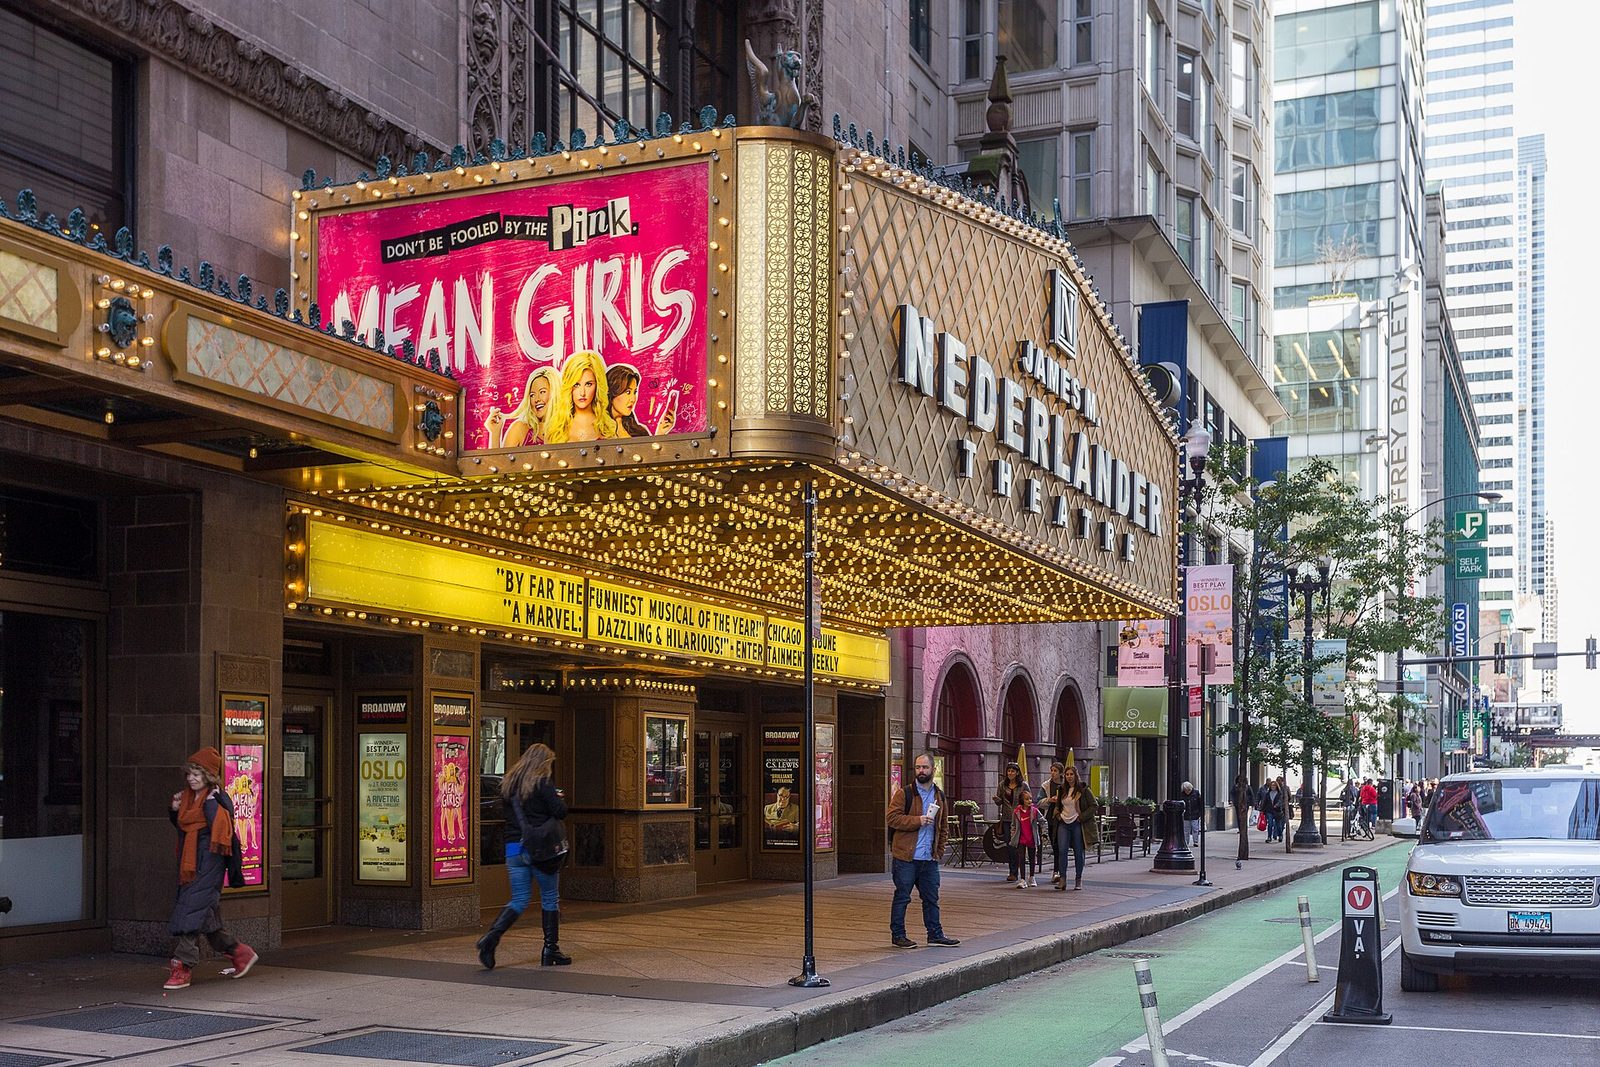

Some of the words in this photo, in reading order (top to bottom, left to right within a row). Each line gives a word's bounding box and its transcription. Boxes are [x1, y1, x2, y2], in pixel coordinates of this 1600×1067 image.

[387, 239, 425, 259] DON'T
[430, 236, 443, 251] BE
[451, 221, 499, 246] FOOLED
[504, 221, 522, 235] BY
[524, 222, 548, 236] THE
[552, 200, 638, 250] Pink.
[332, 270, 494, 373] MEAN
[516, 246, 695, 366] GIRLS
[1391, 301, 1408, 415] BALLET
[1018, 339, 1081, 411] JAMES
[1080, 387, 1100, 428] M.
[898, 303, 1162, 538] NEDERLANDER
[1391, 427, 1407, 504] FREY
[957, 438, 1135, 563] THEATRE
[1460, 557, 1479, 566] SELF
[1460, 565, 1482, 573] PARK
[1188, 594, 1231, 612] OSLO
[529, 574, 554, 600] FAR
[559, 580, 583, 605] THE
[589, 586, 643, 617] FUNNIEST
[649, 599, 695, 626] MUSICAL
[698, 609, 711, 629] OF
[713, 612, 730, 633] THE
[767, 623, 801, 646] CHICAGO
[812, 633, 837, 651] IBUNE
[526, 603, 582, 633] MARVEL:
[598, 616, 652, 643] DAZZLING
[656, 626, 662, 645] &
[1455, 608, 1466, 656] ROSS
[361, 702, 406, 713] BROADWAY
[433, 703, 467, 715] BROADWAY
[232, 718, 262, 727] CHICAGO
[1107, 719, 1137, 731] argo
[1138, 716, 1156, 729] tea
[764, 731, 800, 739] BROADWAY
[361, 760, 406, 780] OSLO
[778, 761, 799, 769] LEWIS
[366, 795, 371, 803] A
[372, 795, 400, 803] RIVETING
[234, 805, 254, 819] GIRLS
[1353, 890, 1366, 906] V
[1525, 918, 1549, 929] 49424
[1353, 919, 1365, 959] VA
